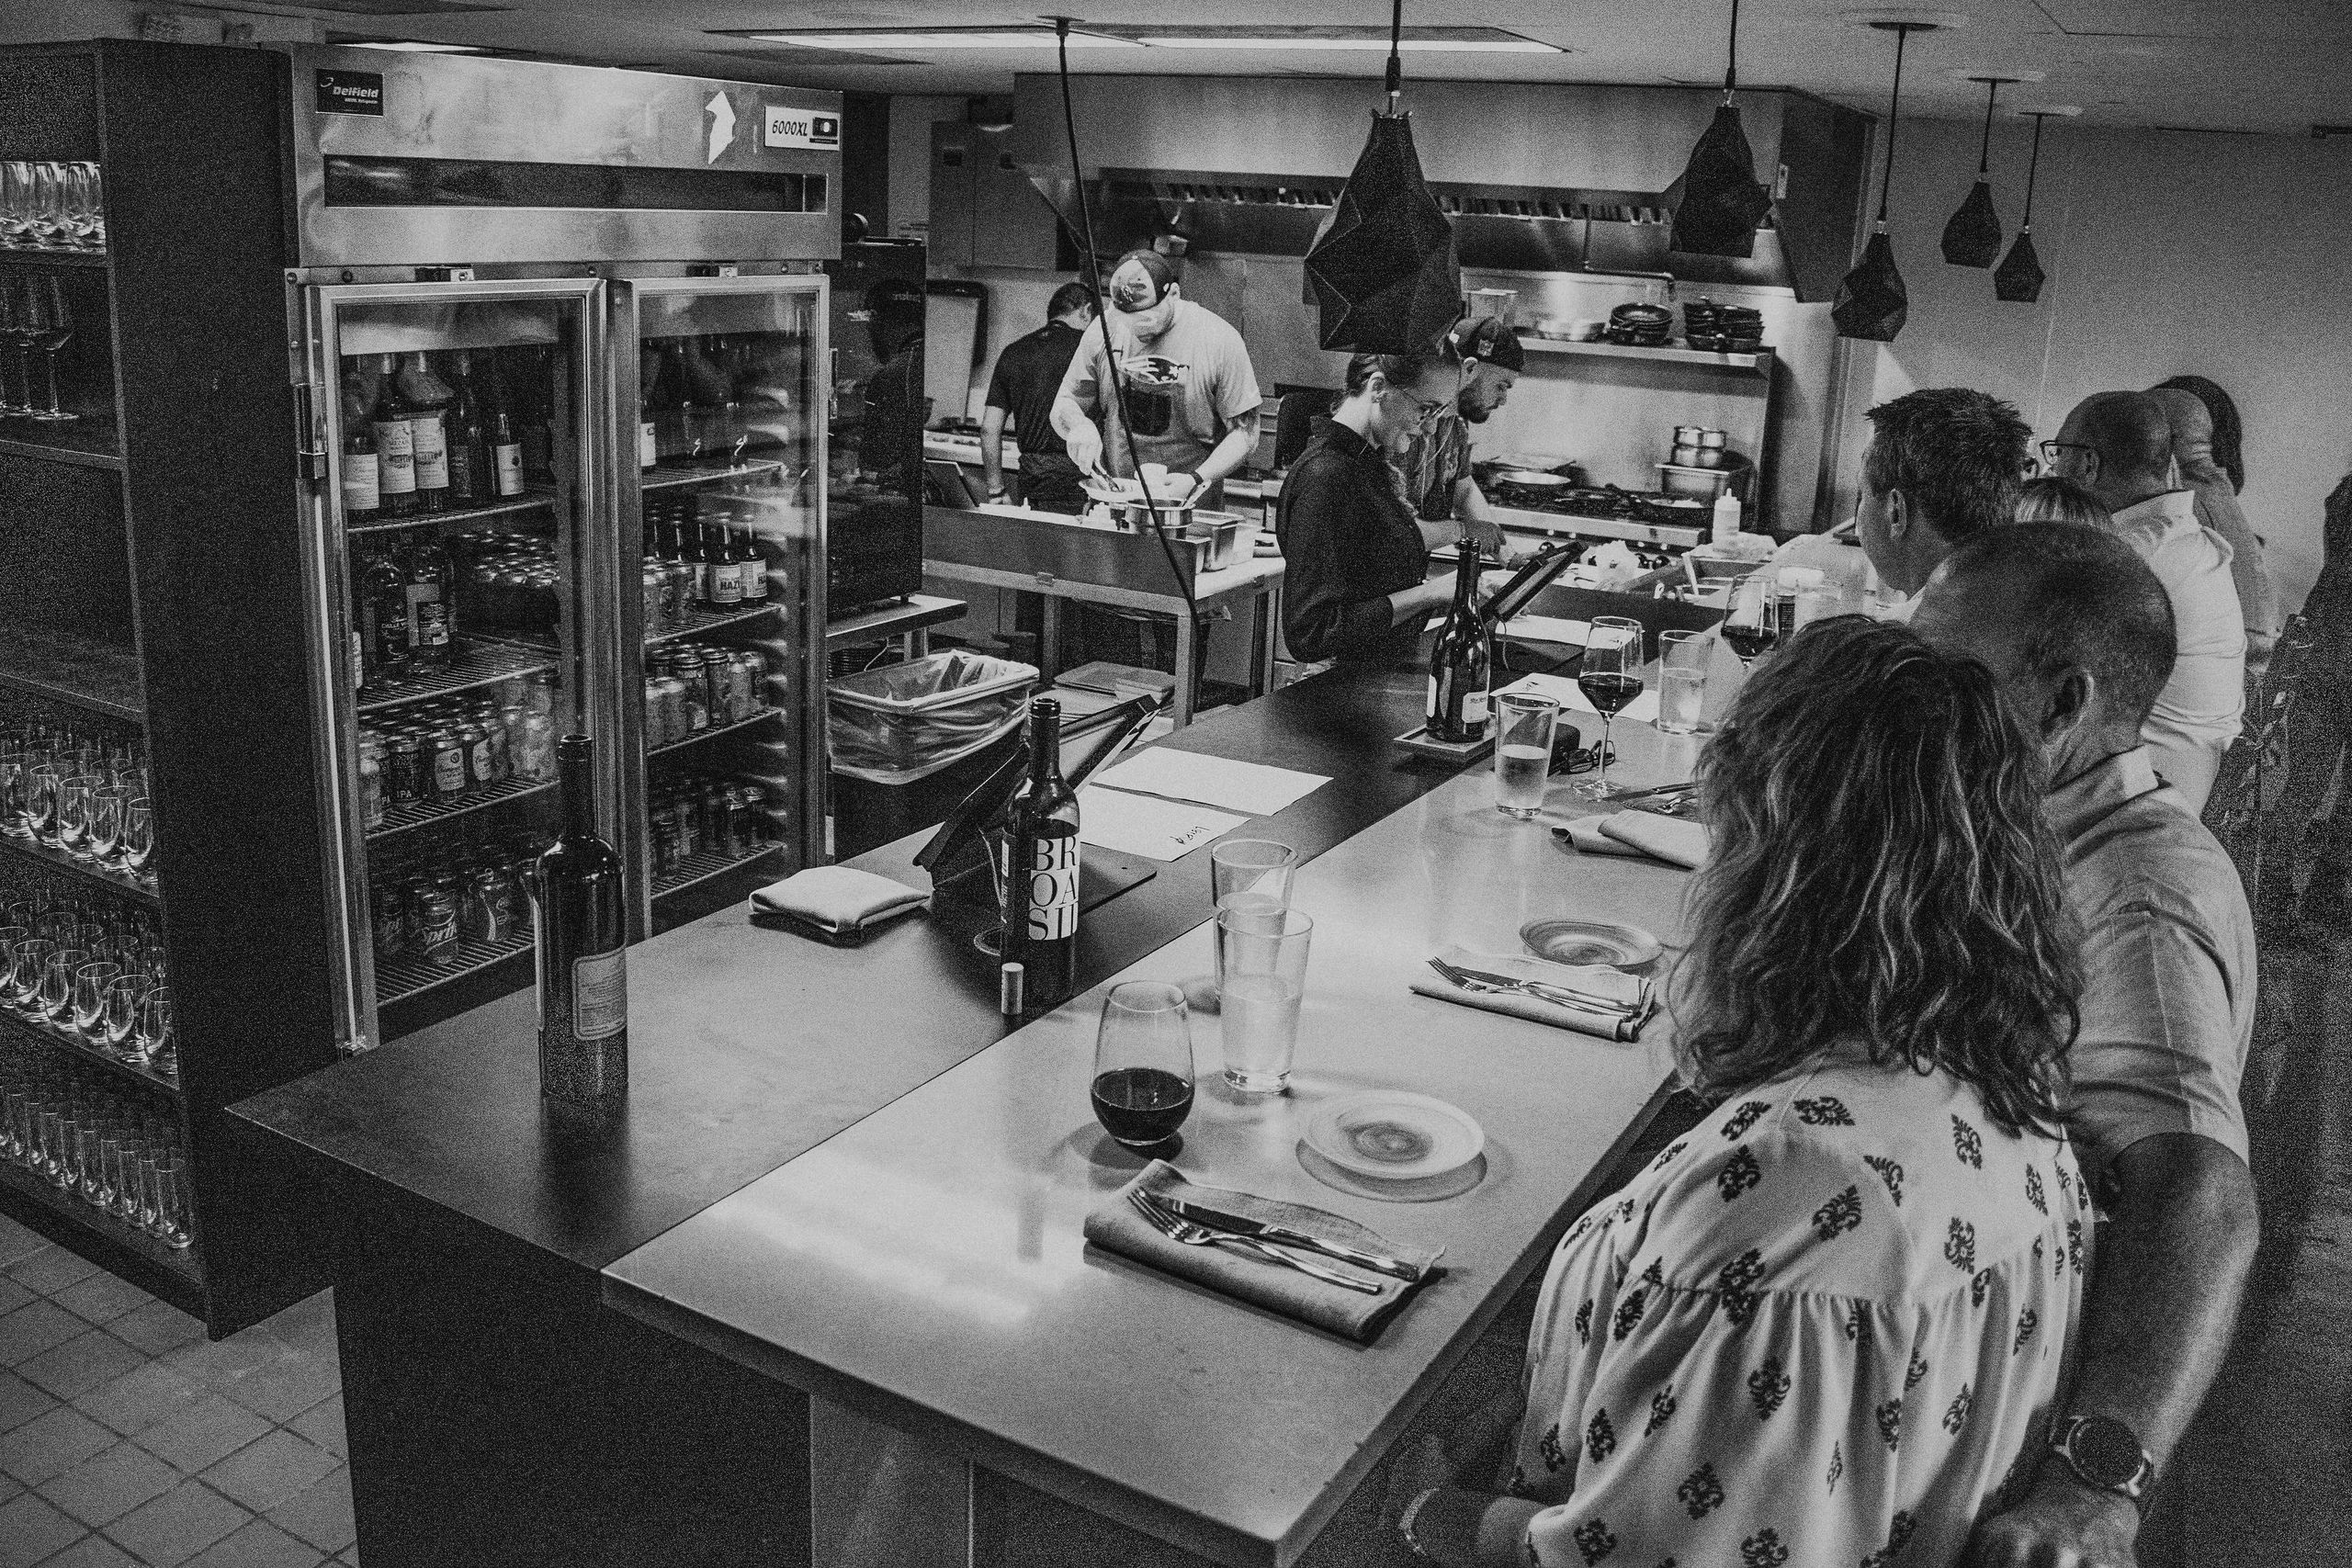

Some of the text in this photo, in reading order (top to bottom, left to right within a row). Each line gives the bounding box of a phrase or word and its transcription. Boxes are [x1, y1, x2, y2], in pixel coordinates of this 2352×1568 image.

[333, 86, 379, 98] Delfield
[772, 119, 808, 137] 6000XL
[422, 920, 458, 946] Sprit
